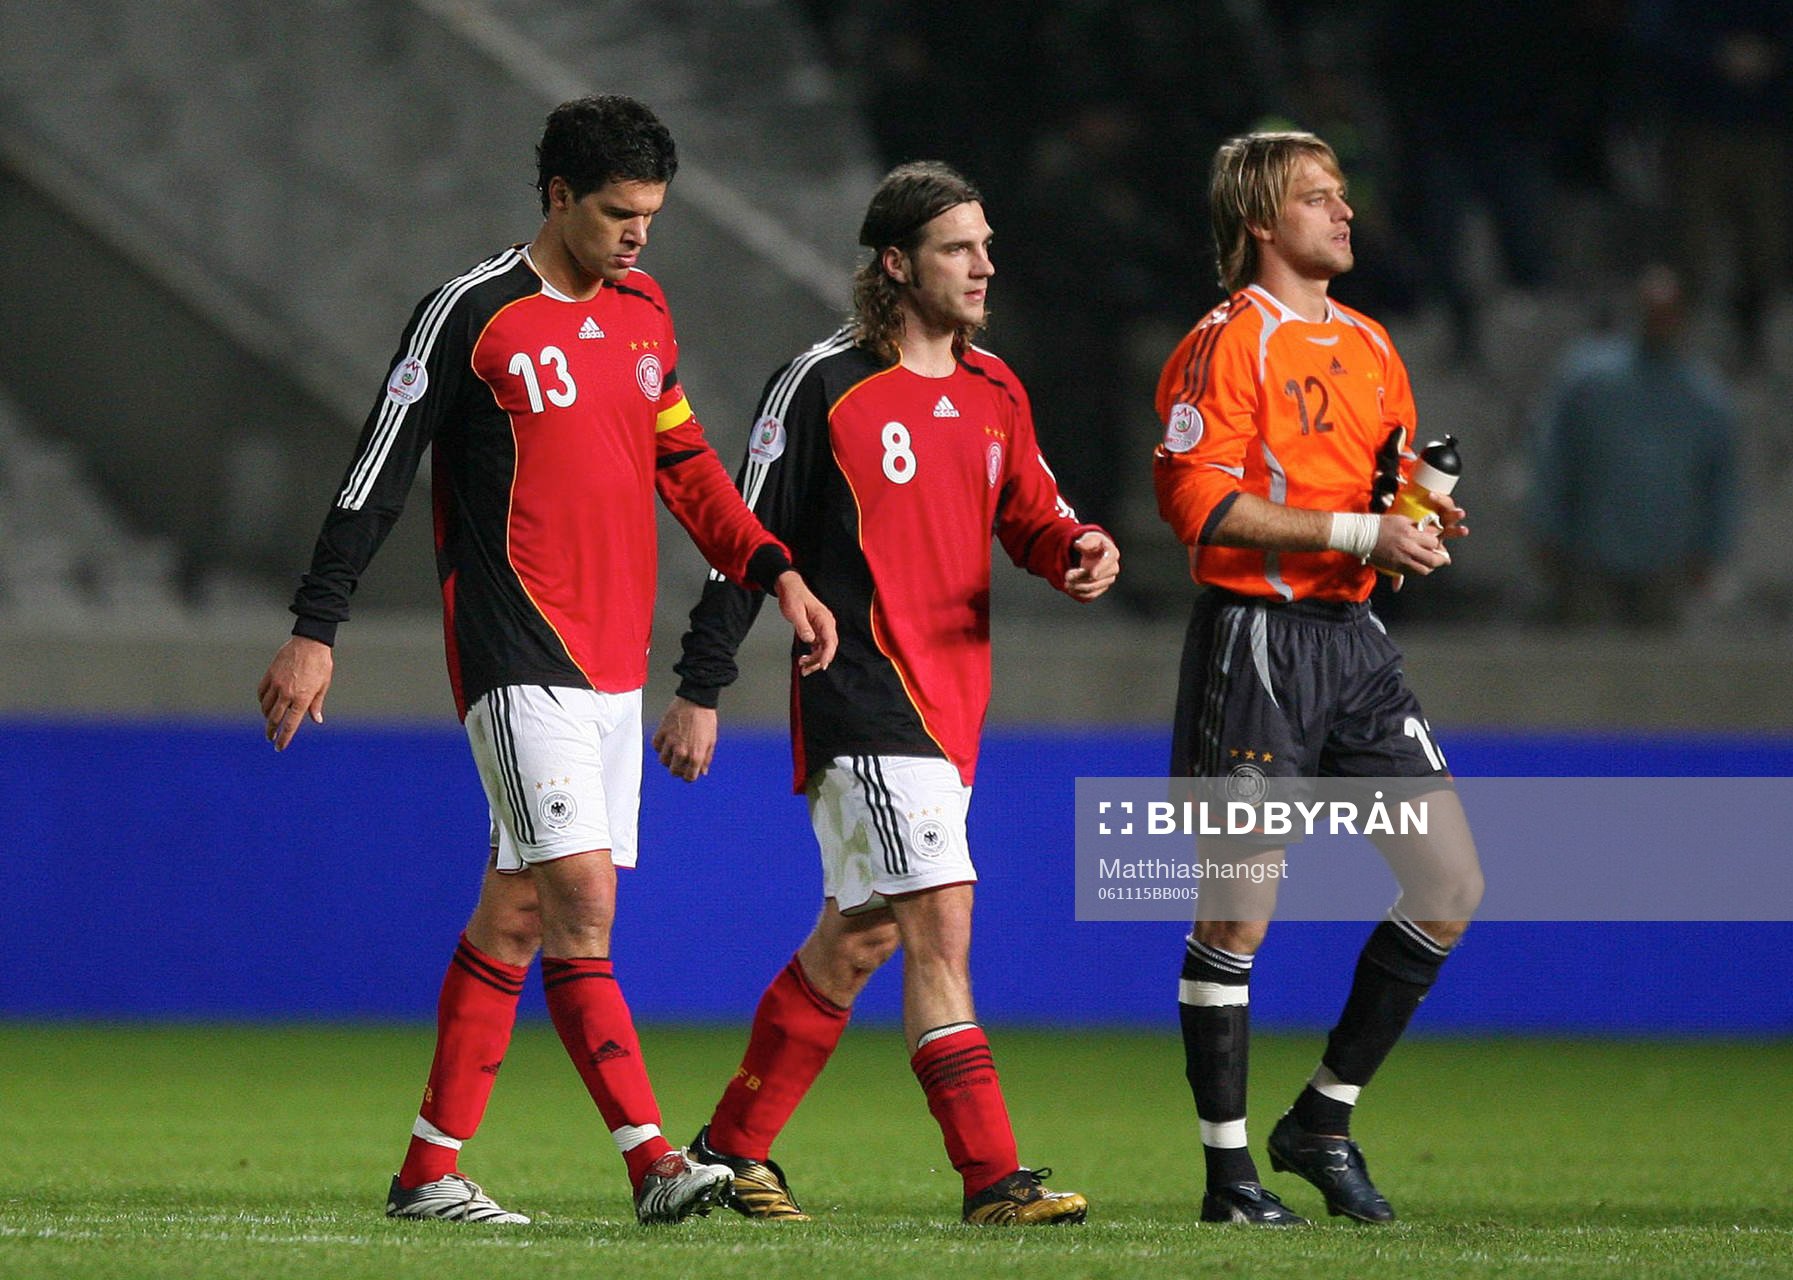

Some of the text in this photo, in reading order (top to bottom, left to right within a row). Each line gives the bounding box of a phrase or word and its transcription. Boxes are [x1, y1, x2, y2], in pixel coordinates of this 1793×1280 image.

[578, 331, 605, 339] adidas
[508, 345, 577, 413] 13
[1285, 376, 1333, 436] 12
[933, 409, 960, 417] adidas
[881, 421, 917, 484] 8
